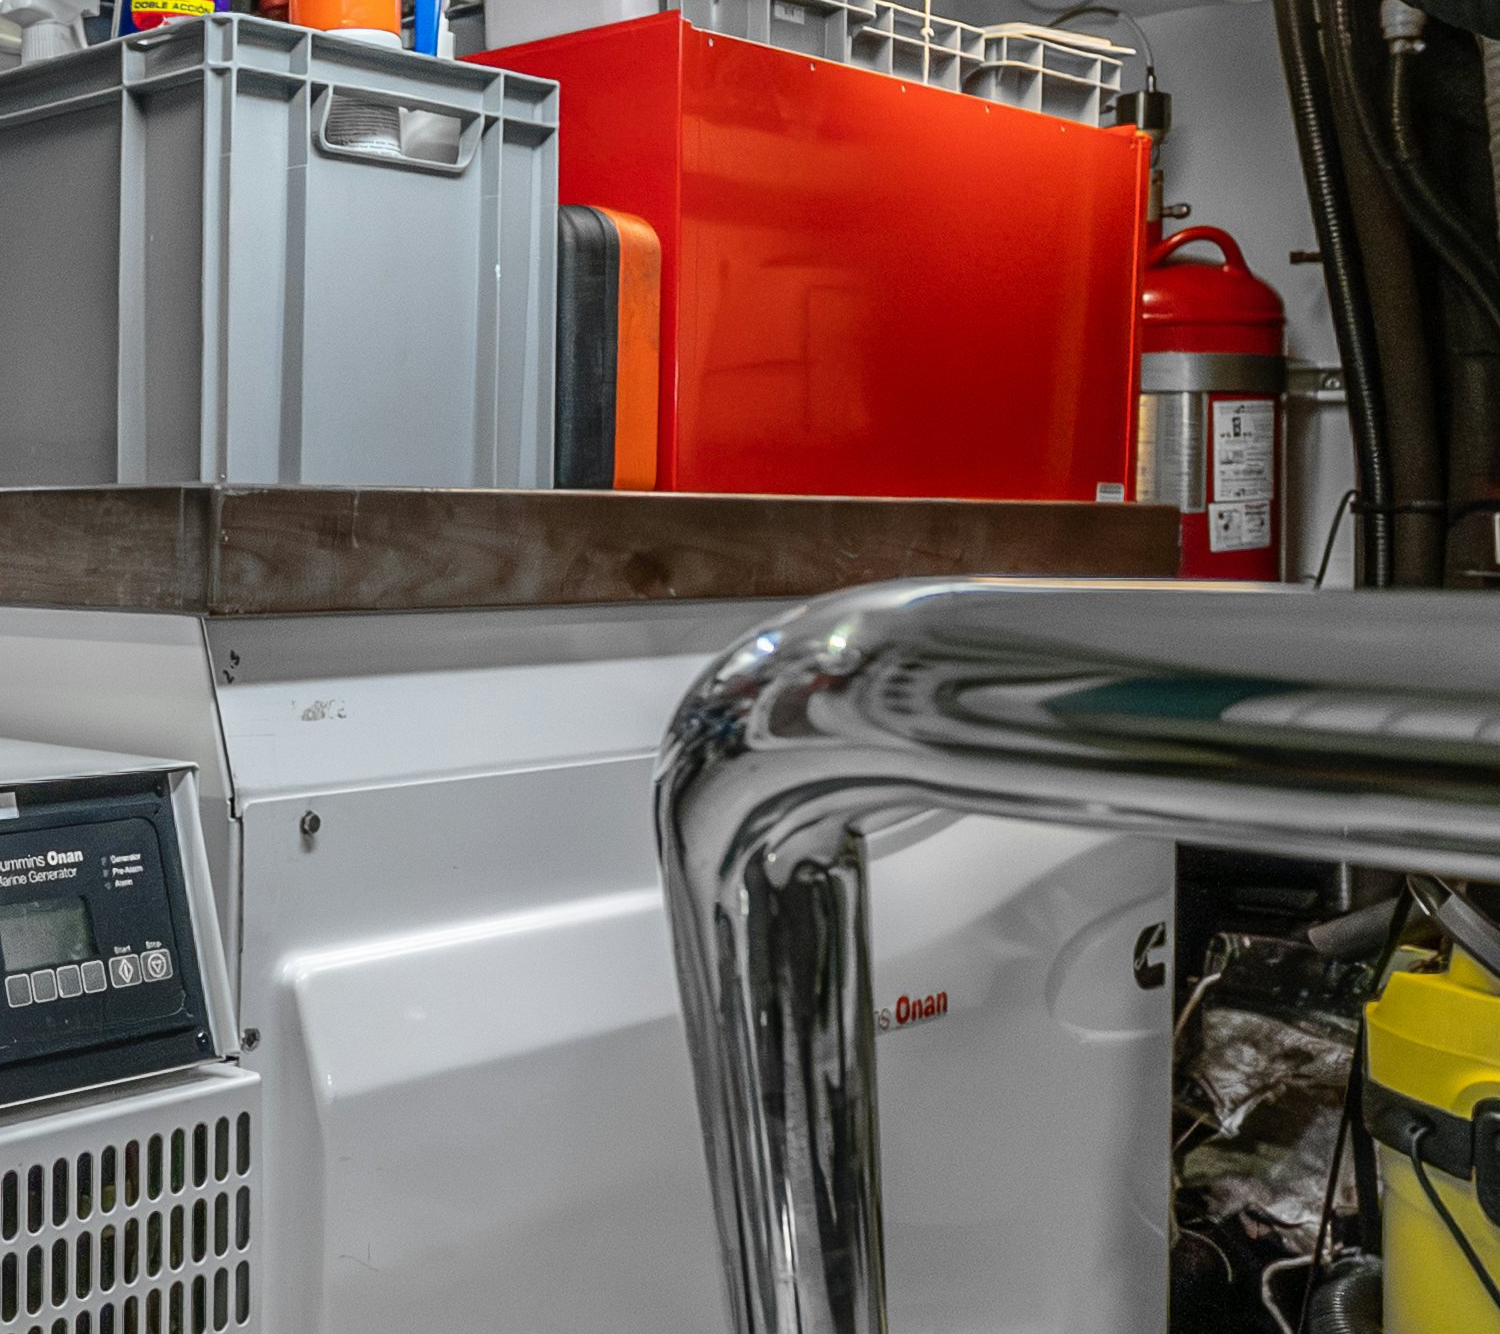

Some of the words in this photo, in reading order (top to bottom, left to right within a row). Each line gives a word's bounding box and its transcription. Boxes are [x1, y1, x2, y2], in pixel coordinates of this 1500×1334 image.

[46, 850, 84, 866] Onan
[28, 867, 78, 883] Generator
[896, 991, 948, 1025] Onan
